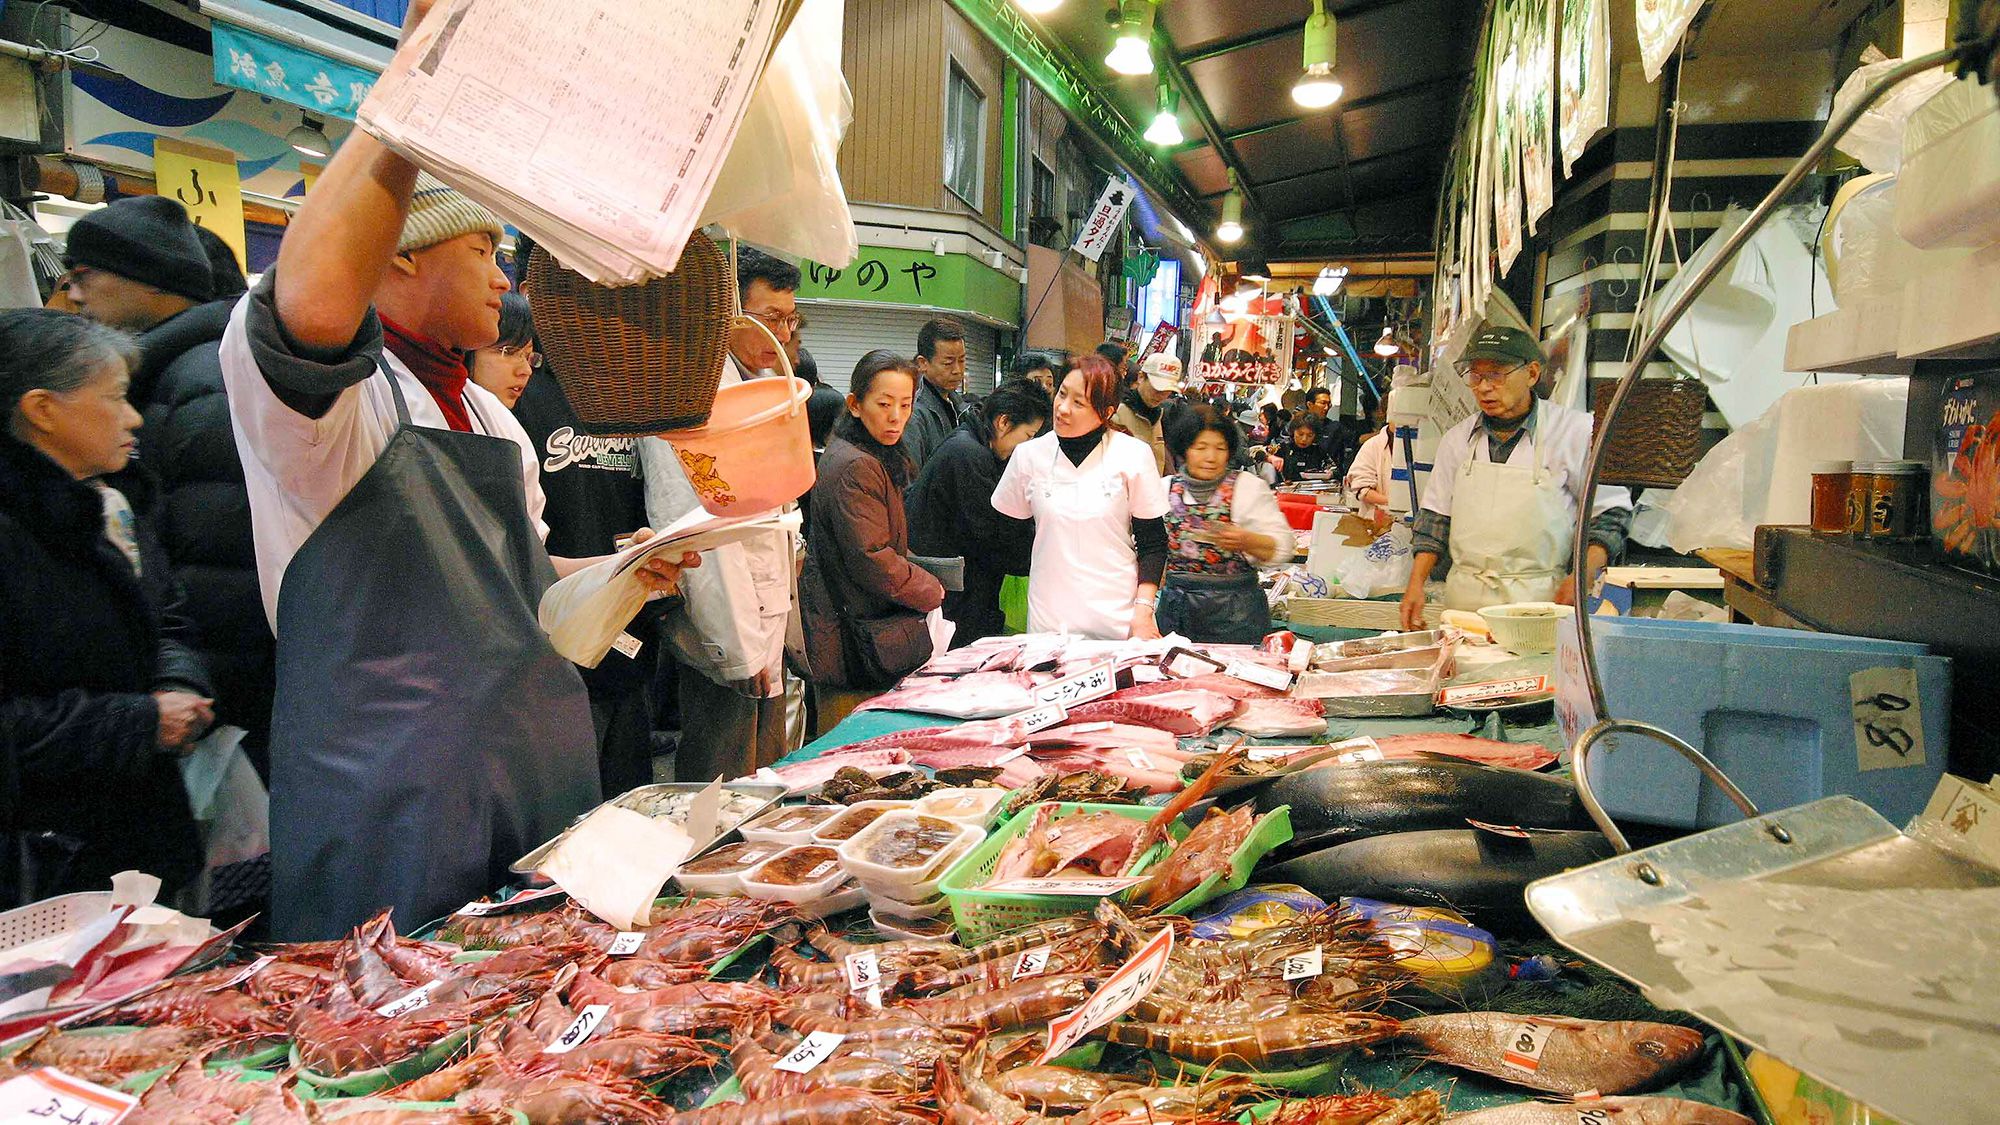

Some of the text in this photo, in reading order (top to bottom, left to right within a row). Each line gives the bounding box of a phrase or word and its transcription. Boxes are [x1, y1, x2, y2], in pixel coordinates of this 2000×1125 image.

[177, 168, 217, 225] ふ
[808, 260, 937, 297] ゆのや
[1194, 361, 1282, 383] ぬかみそだき
